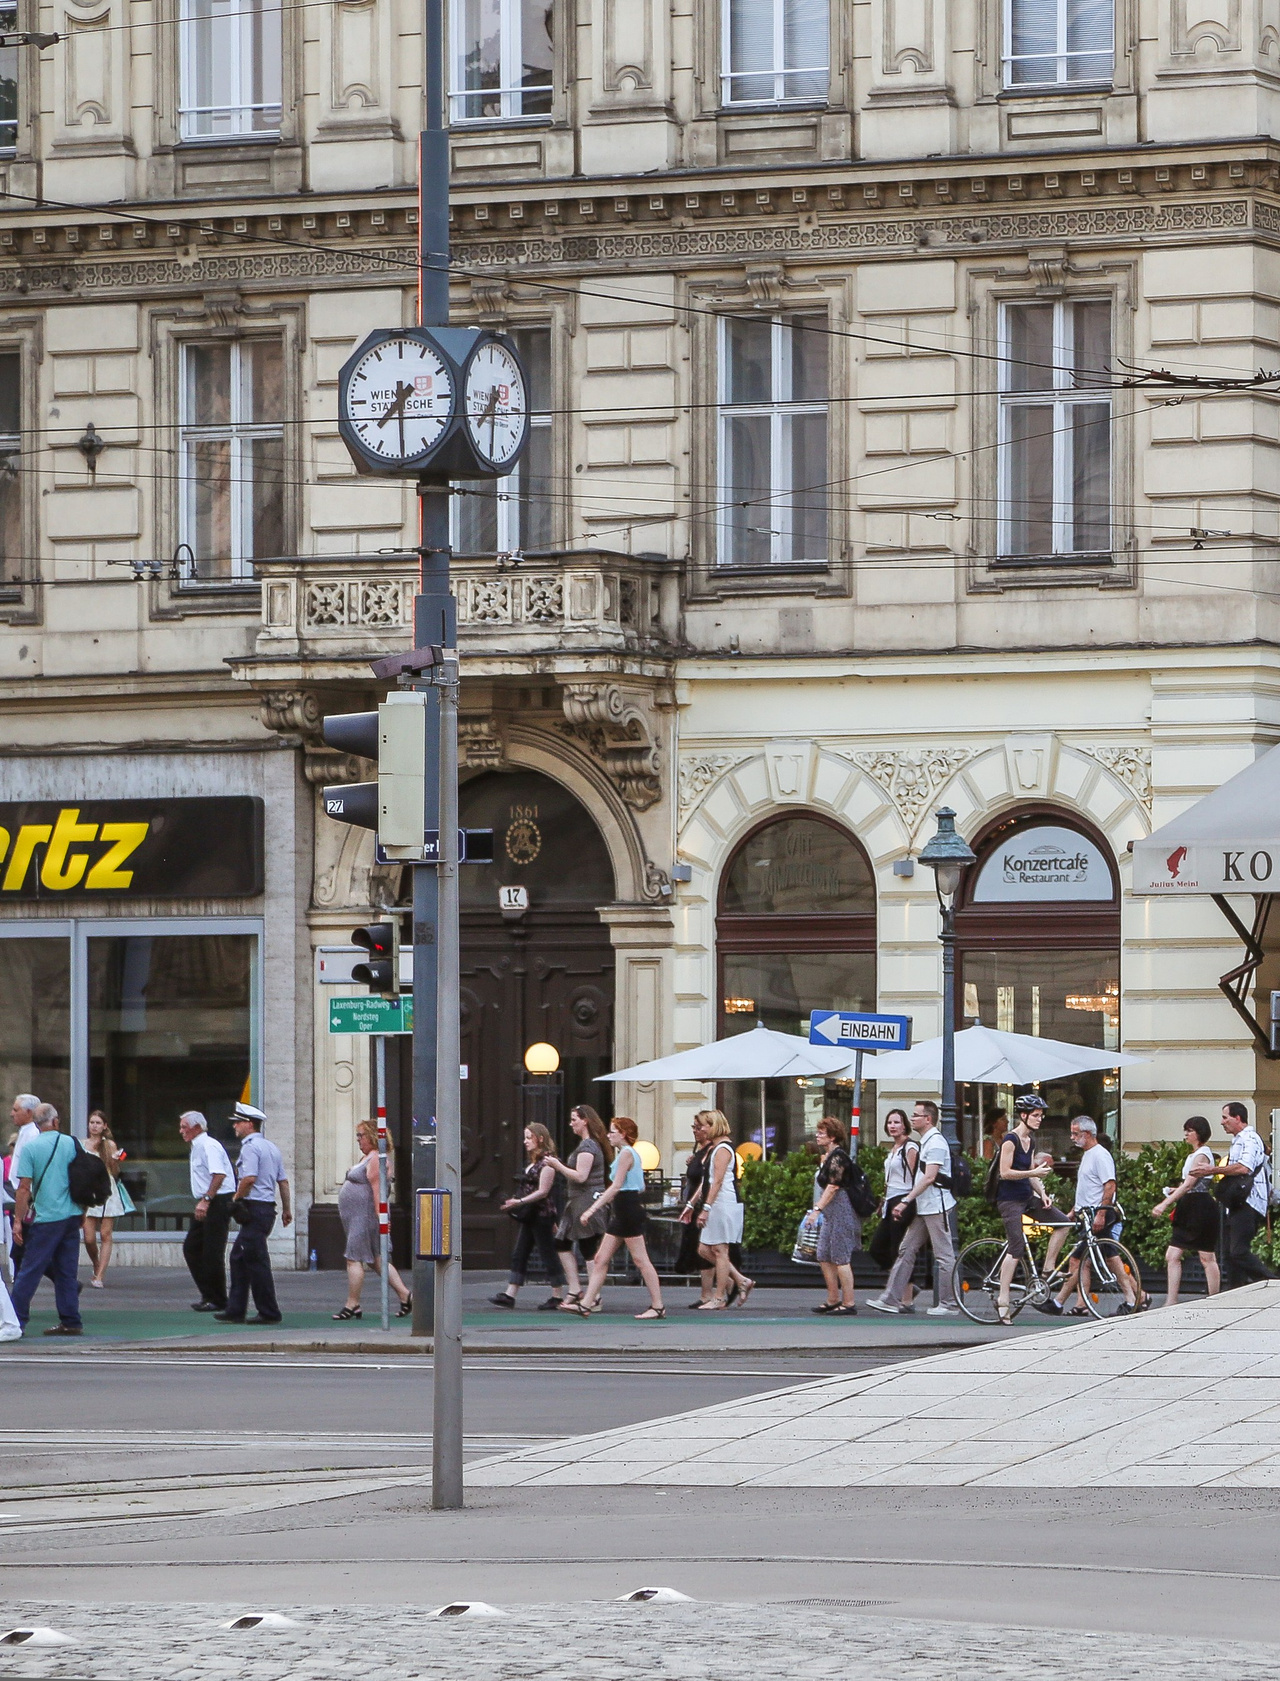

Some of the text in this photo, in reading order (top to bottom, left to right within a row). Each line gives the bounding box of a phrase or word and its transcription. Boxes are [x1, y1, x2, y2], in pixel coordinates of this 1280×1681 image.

[371, 389, 411, 400] WIEN
[328, 800, 343, 813] 27
[509, 805, 538, 819] 1861
[0, 808, 149, 890] rtz
[1003, 854, 1088, 872] Konzertcafé
[1019, 872, 1069, 883] Restaurant
[506, 888, 520, 903] 17
[359, 1022, 373, 1031] Oper
[841, 1022, 895, 1039] EINBAHN
